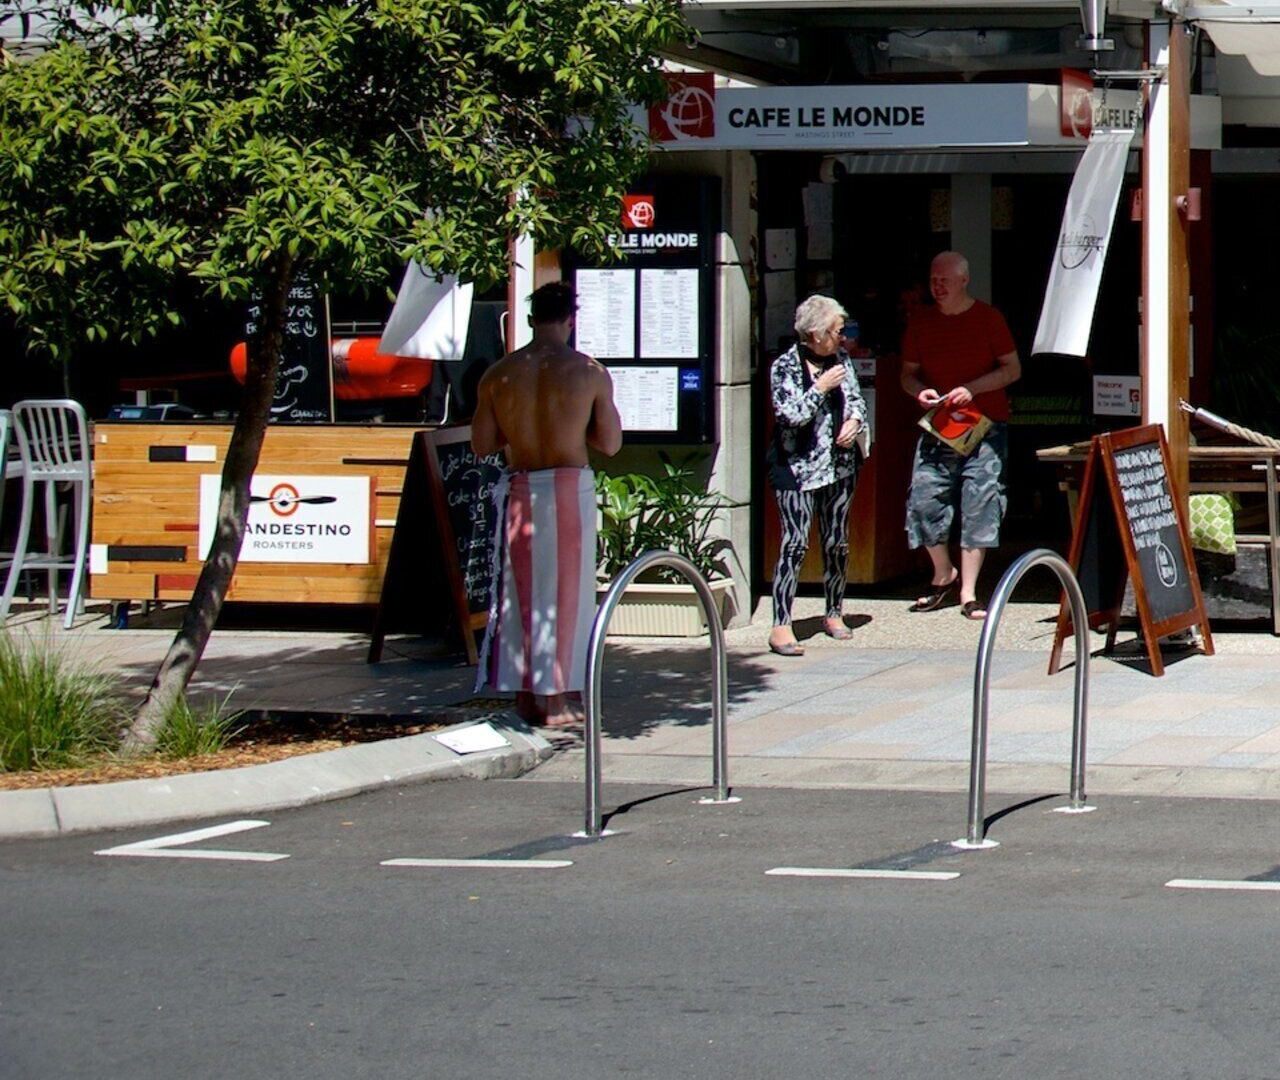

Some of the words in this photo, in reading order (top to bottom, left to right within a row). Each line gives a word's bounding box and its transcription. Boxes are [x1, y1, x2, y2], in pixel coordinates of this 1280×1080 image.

[728, 107, 791, 128] CAFE
[797, 107, 826, 127] LE
[832, 106, 925, 127] MONDE
[641, 233, 698, 247] MONDE
[244, 523, 351, 536] ANDESTINO
[253, 540, 314, 550] ROASTERS
